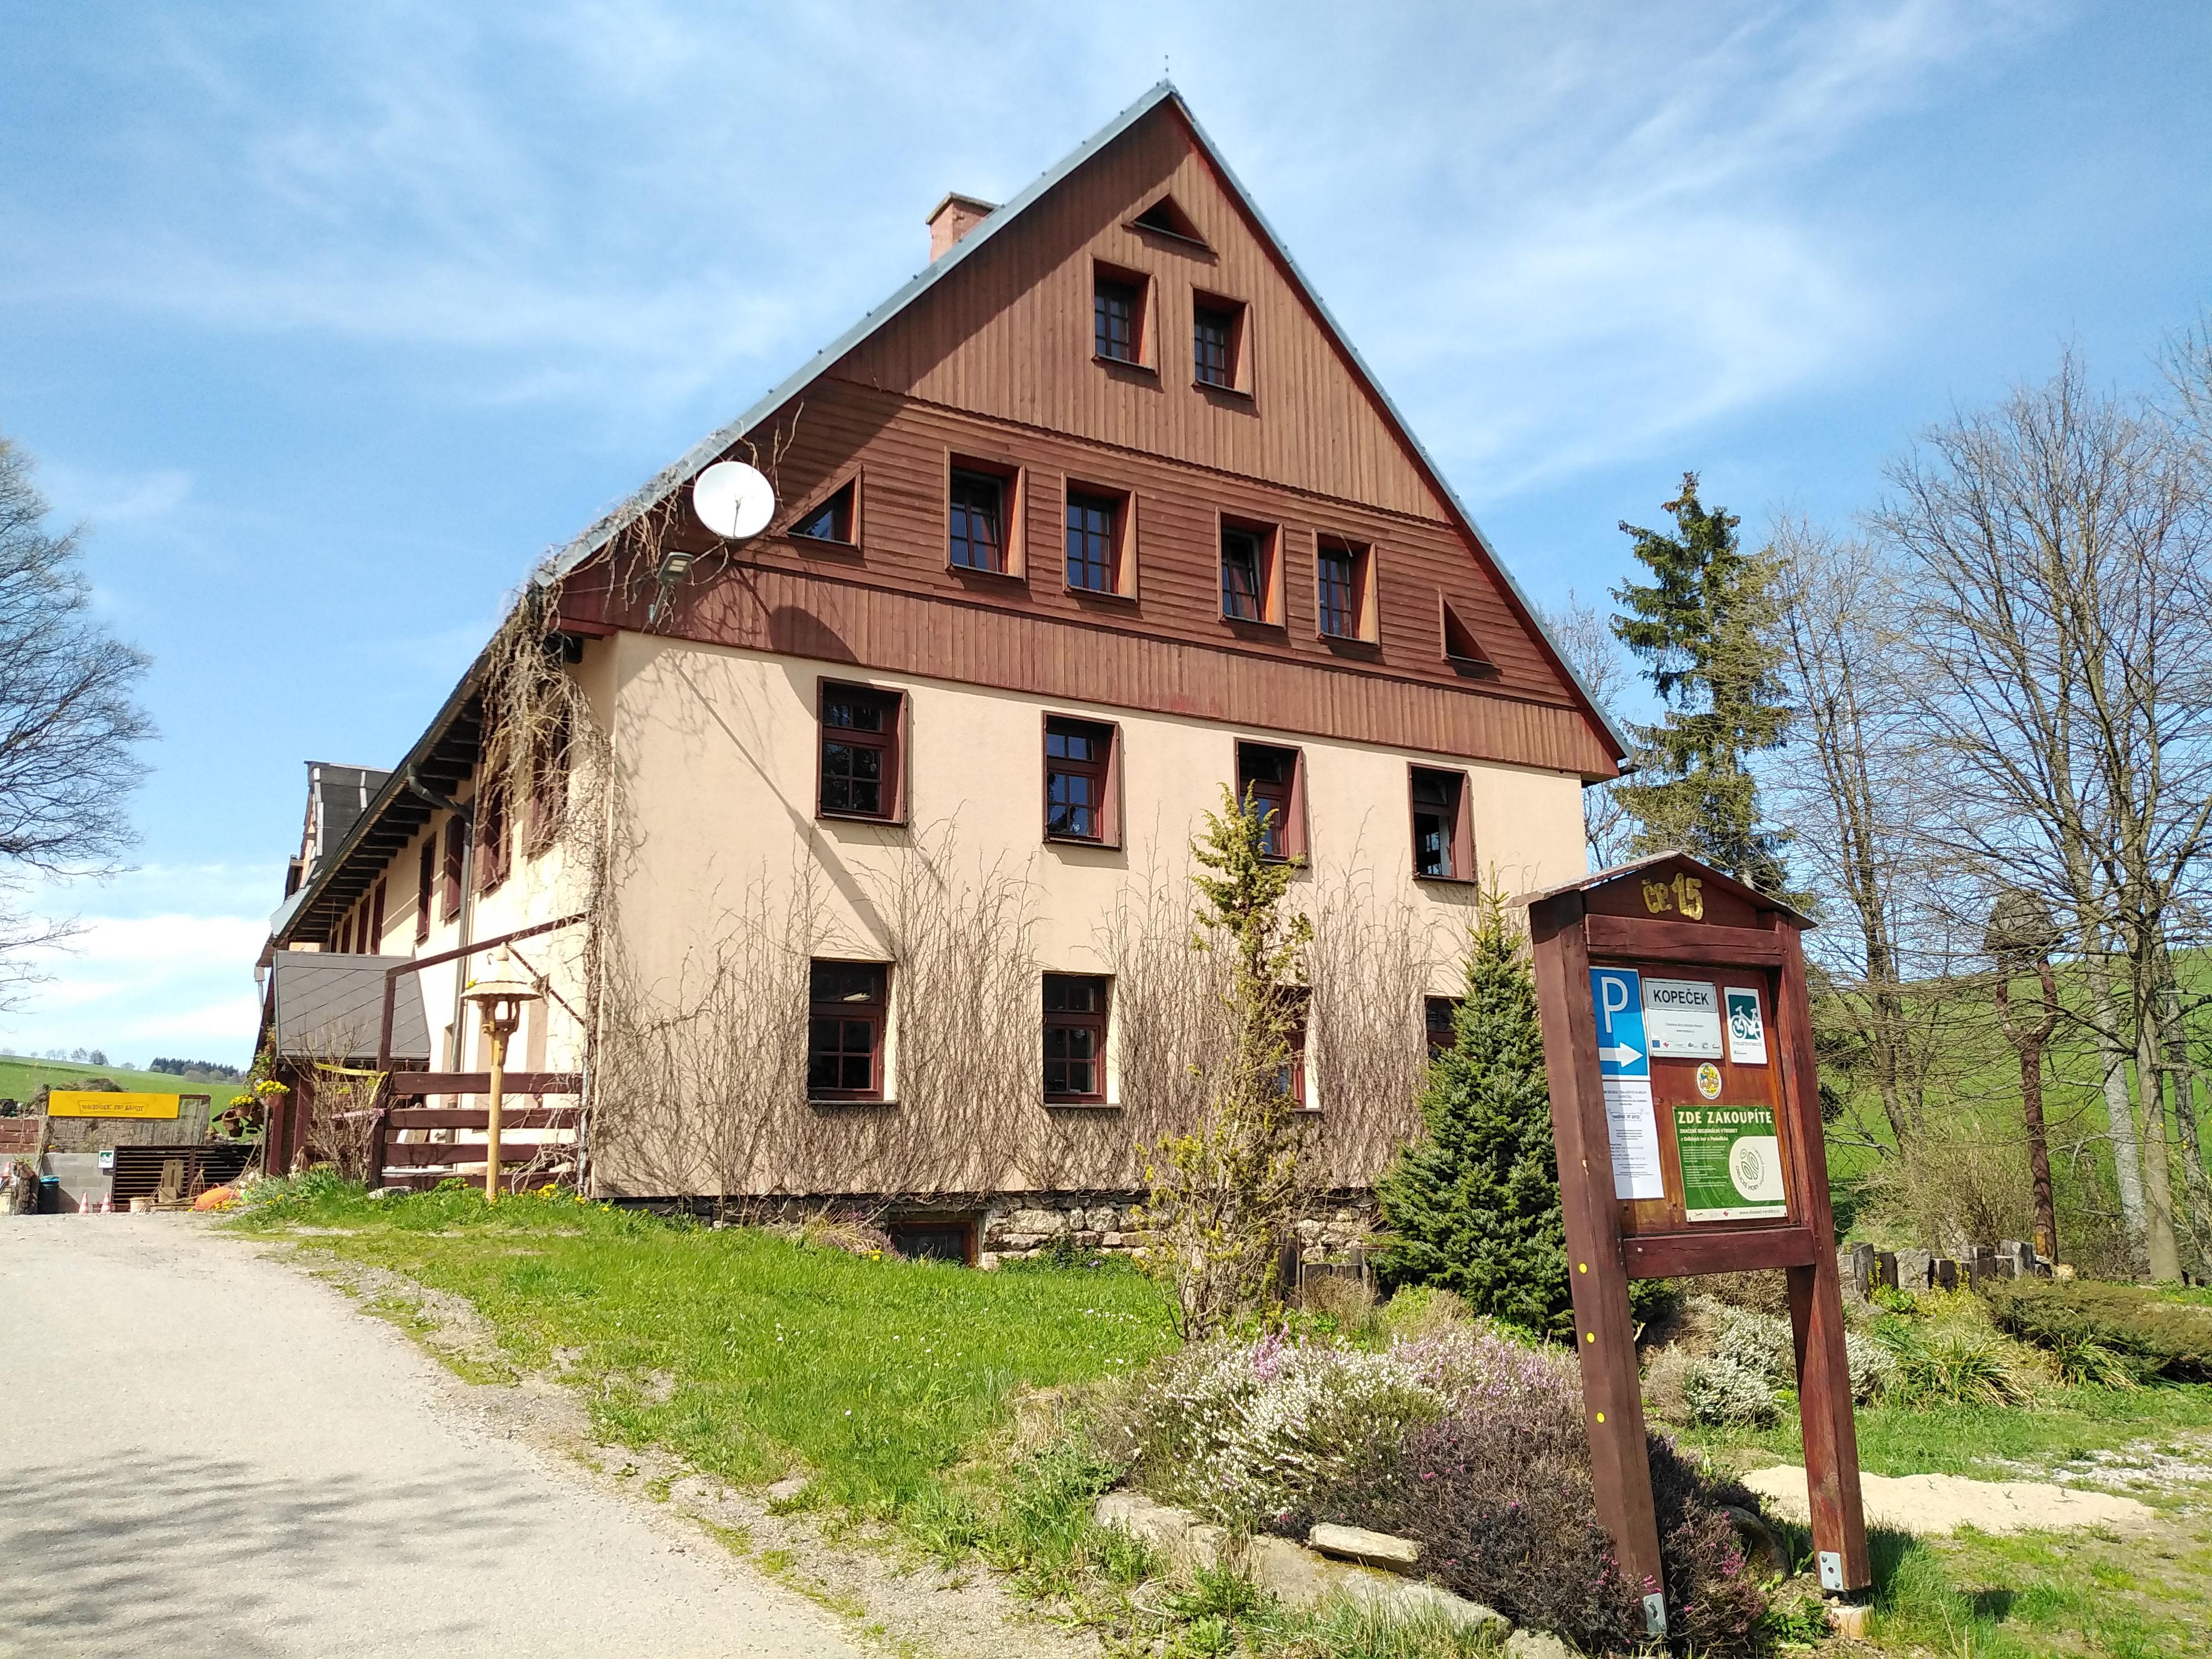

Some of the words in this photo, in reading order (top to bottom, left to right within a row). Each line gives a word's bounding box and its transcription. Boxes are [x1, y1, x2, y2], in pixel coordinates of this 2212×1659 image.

[1670, 872, 1703, 921] 15
[1601, 976, 1629, 1033] P
[1652, 988, 1710, 1006] KOPEČEK
[1678, 1112, 1702, 1124] ZDE
[1707, 1108, 1772, 1124] ZAKOUPÍTE
